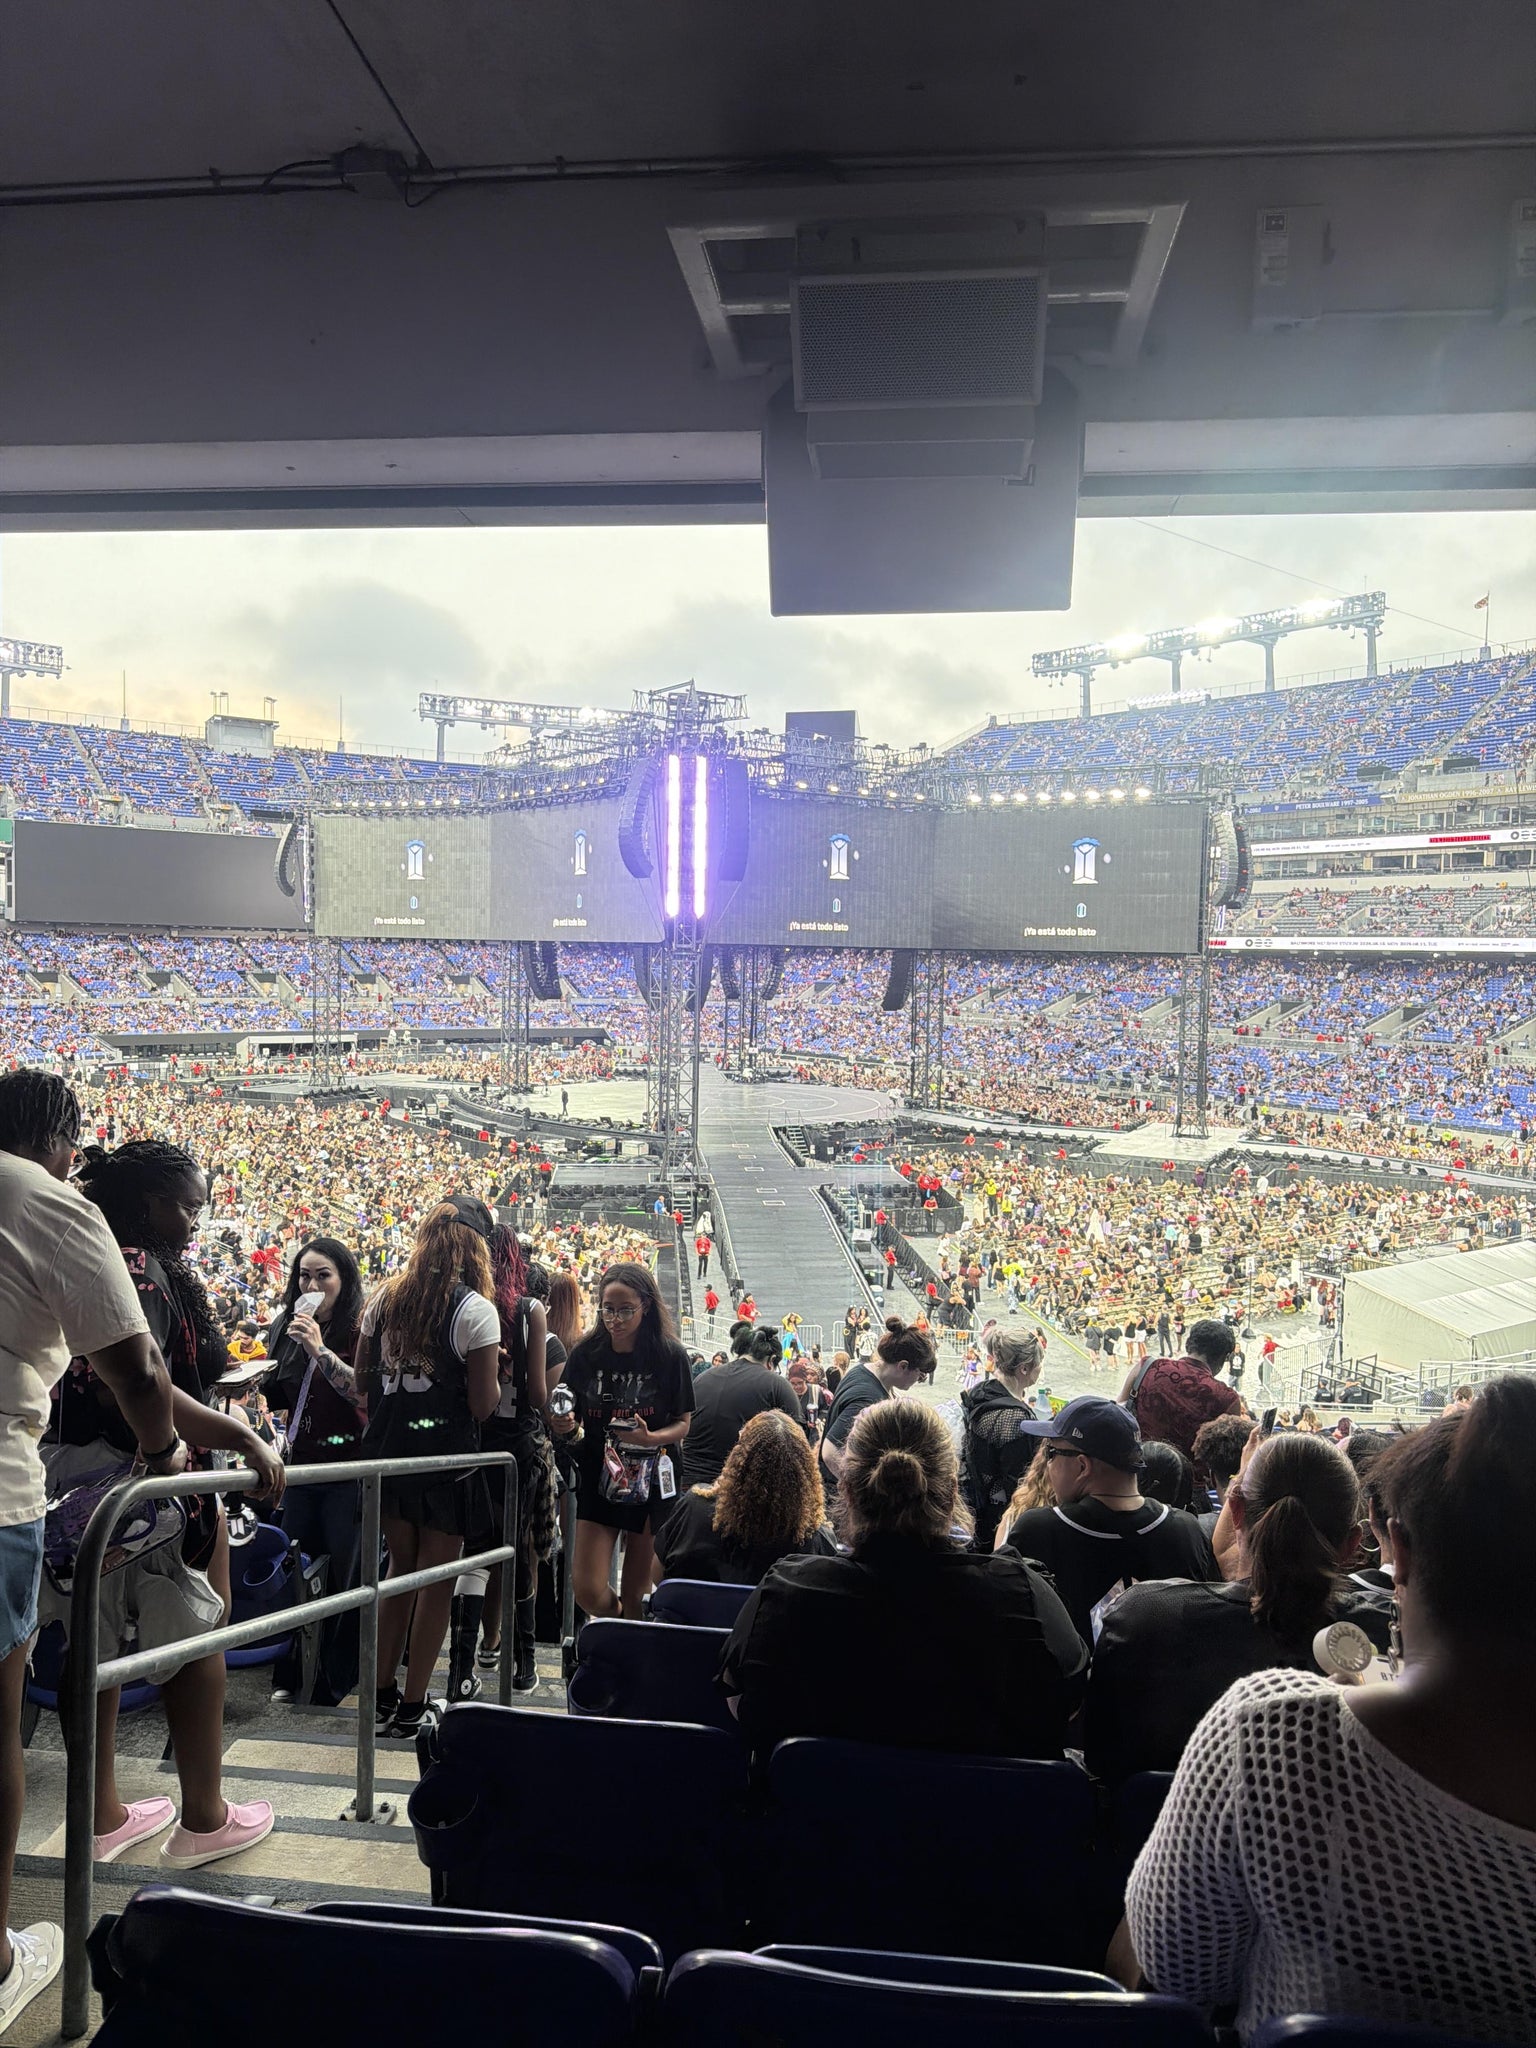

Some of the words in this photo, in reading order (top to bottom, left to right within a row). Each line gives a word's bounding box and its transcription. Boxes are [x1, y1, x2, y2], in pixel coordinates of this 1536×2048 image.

[1408, 793, 1439, 801] JONATHAN
[1440, 791, 1460, 799] OGDEN
[817, 922, 833, 931] todo
[1057, 926, 1076, 936] todo
[1078, 927, 1096, 936] listo
[1380, 1671, 1400, 1681] BT
